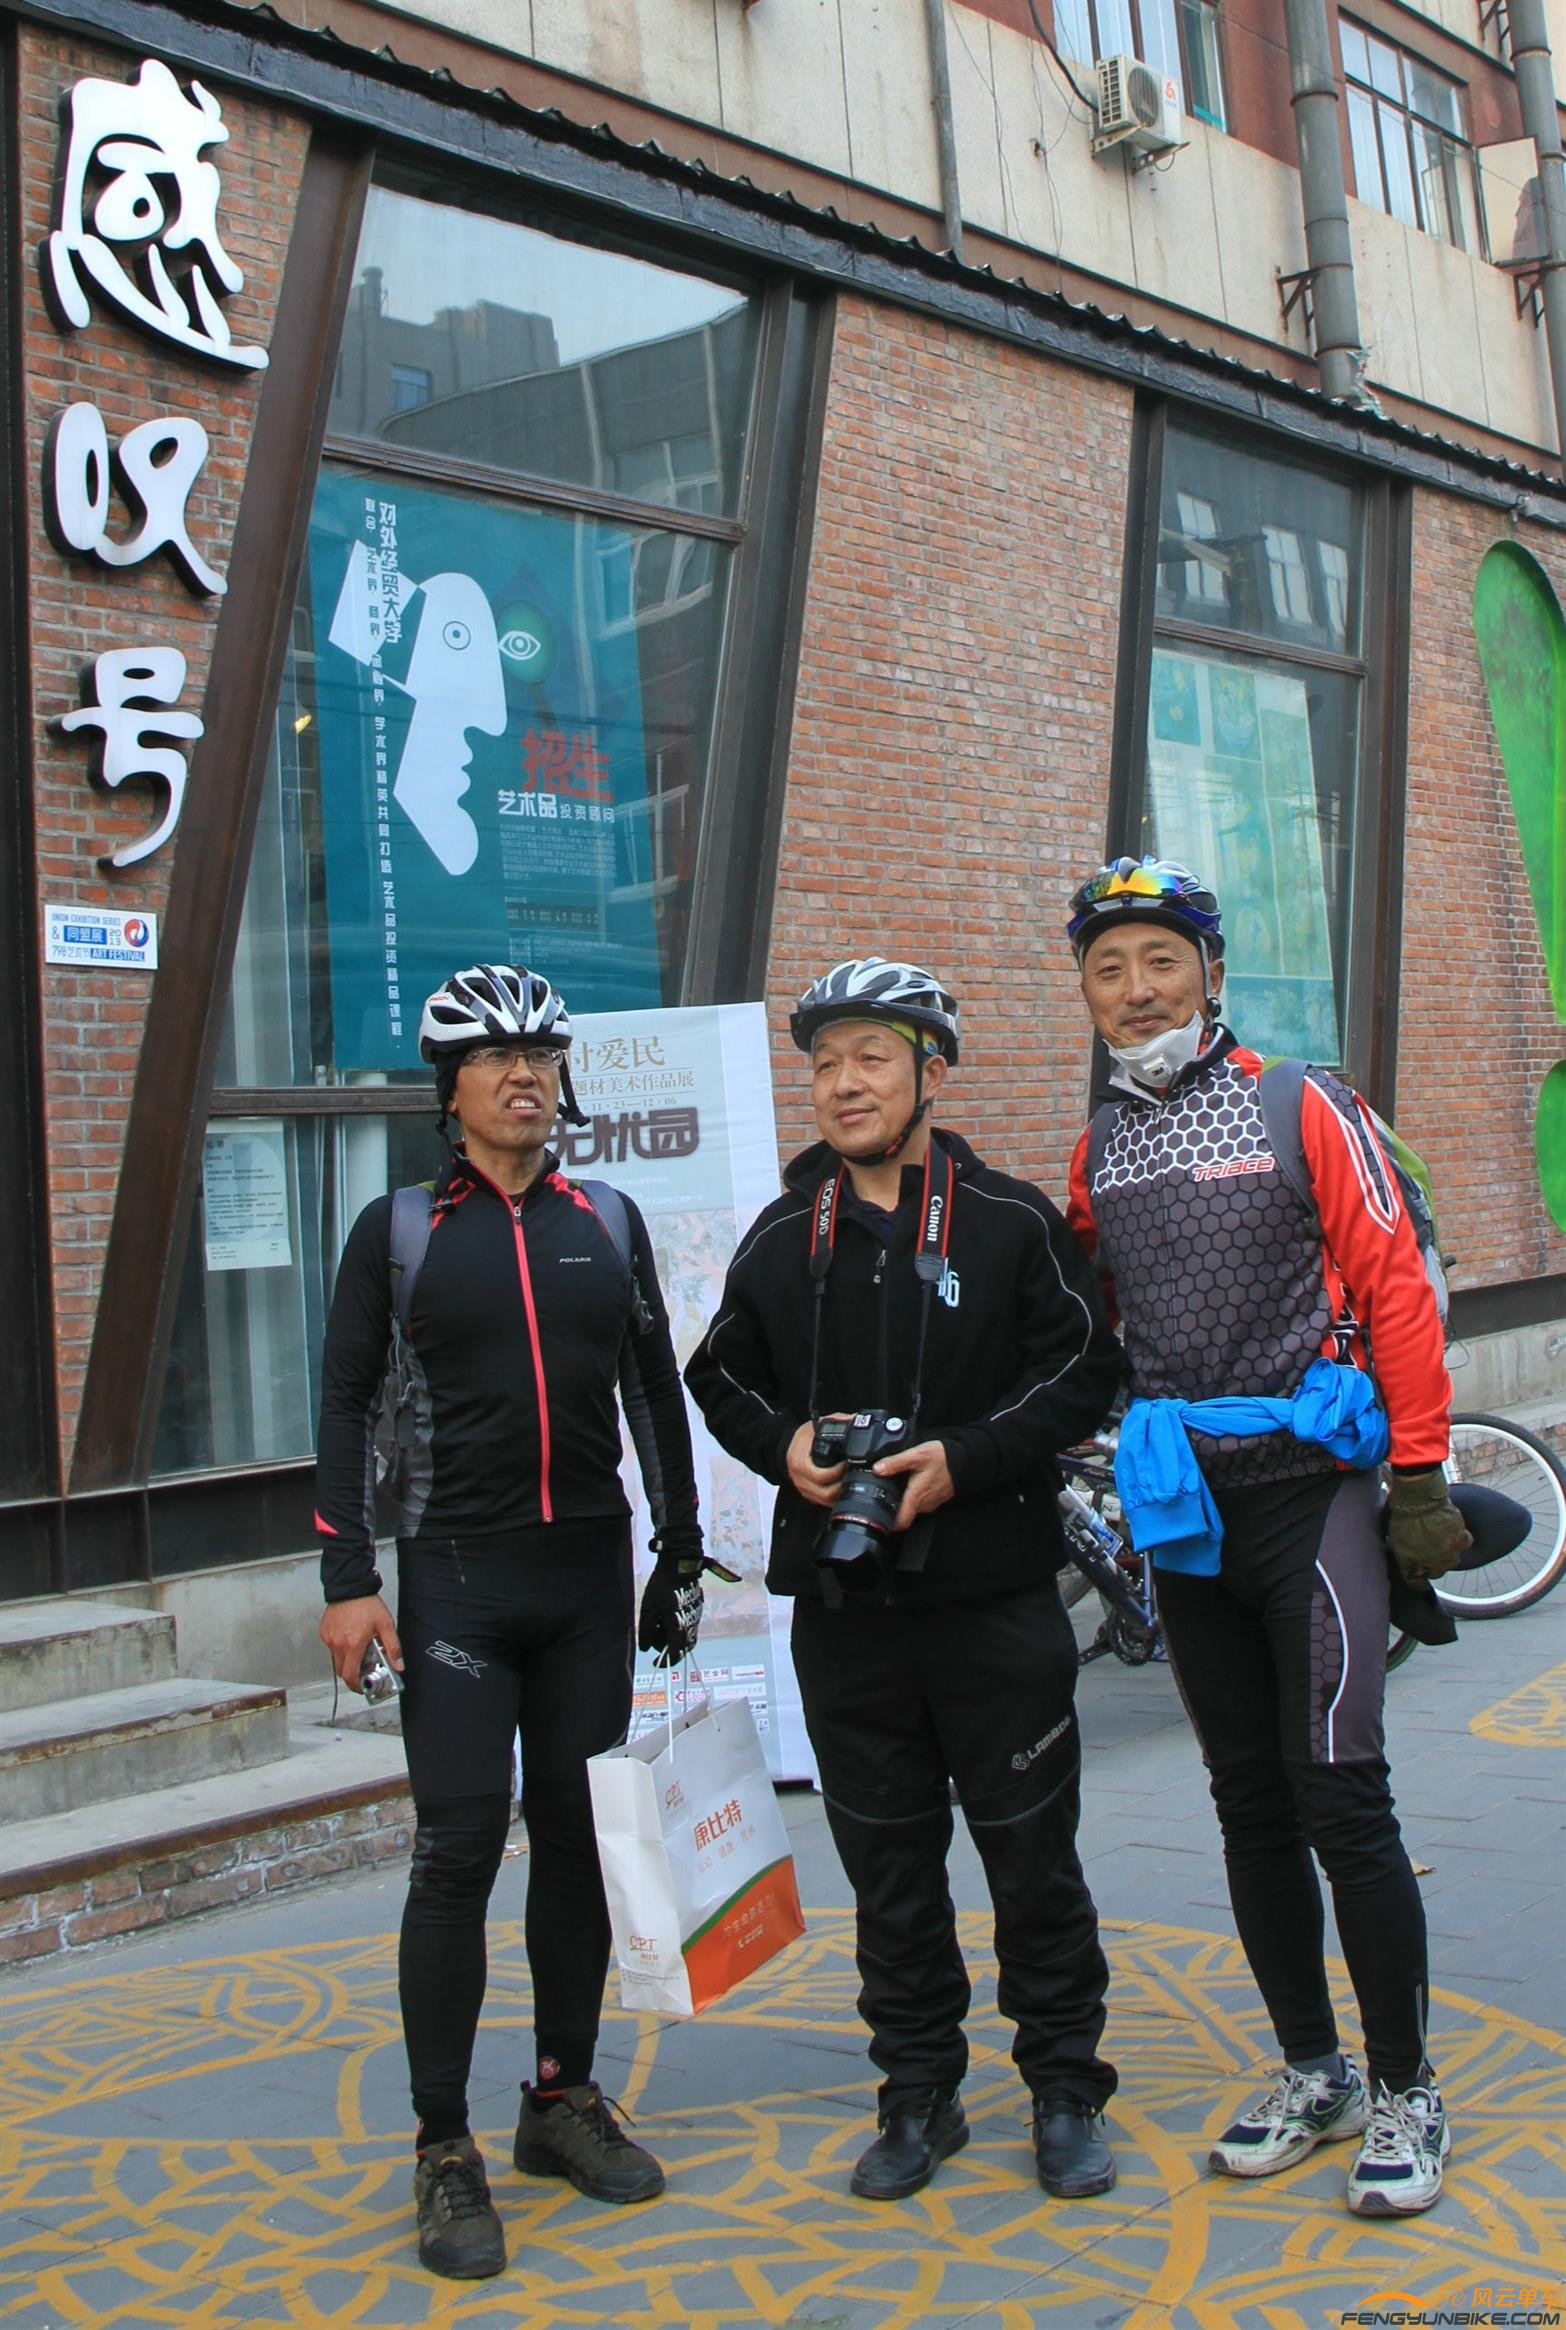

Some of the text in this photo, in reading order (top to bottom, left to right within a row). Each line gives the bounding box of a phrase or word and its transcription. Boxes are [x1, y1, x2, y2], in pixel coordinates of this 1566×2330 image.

[379, 501, 403, 644] 对外经贸大学
[521, 729, 615, 803] 招生
[66, 926, 104, 943] 同盟展
[108, 949, 145, 961] FESTIVAL
[821, 1177, 836, 1210] EOS
[926, 1195, 944, 1242] Canon
[694, 1799, 743, 1851] 康比特
